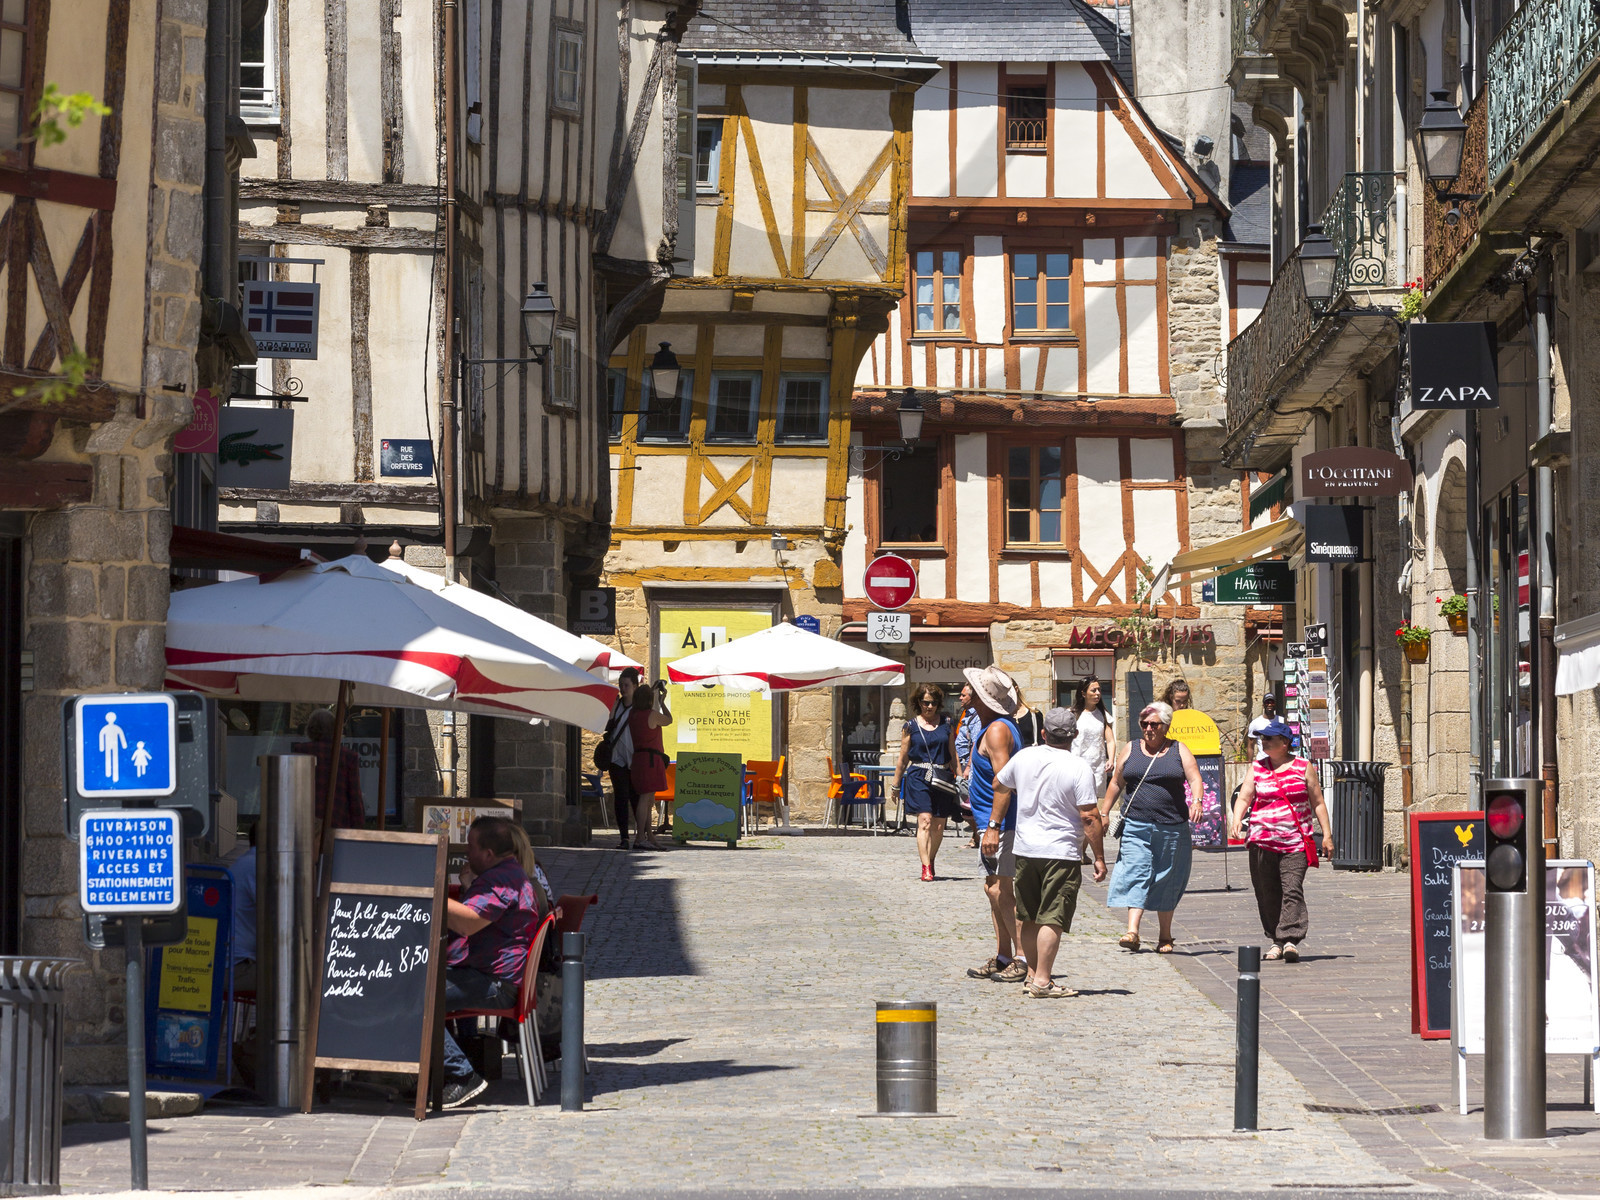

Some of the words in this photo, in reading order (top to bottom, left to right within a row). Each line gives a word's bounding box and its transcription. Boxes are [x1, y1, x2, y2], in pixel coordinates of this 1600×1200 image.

[1420, 386, 1492, 402] ZAPA
[1308, 466, 1394, 480] L'OCCITANE
[1310, 542, 1358, 557] Sinéquanone
[1235, 577, 1277, 590] HAVANE
[580, 590, 608, 620] B
[878, 615, 901, 623] SAUF
[915, 656, 982, 673] Bijouterie
[679, 788, 735, 797] Multi-Marques
[93, 821, 166, 832] LIVRAISON
[92, 849, 168, 860] RIVERAINS
[98, 863, 139, 874] ACCES
[148, 862, 163, 873] ET
[88, 877, 173, 888] STATIONNEMENT
[89, 891, 171, 902] REGLEMENTE
[1471, 920, 1477, 931] 2
[195, 938, 211, 946] foule
[185, 947, 210, 955] Macron
[399, 945, 429, 973] 8,50
[367, 959, 393, 980] plats
[177, 975, 196, 984] Trafic
[171, 985, 200, 994] perturbé
